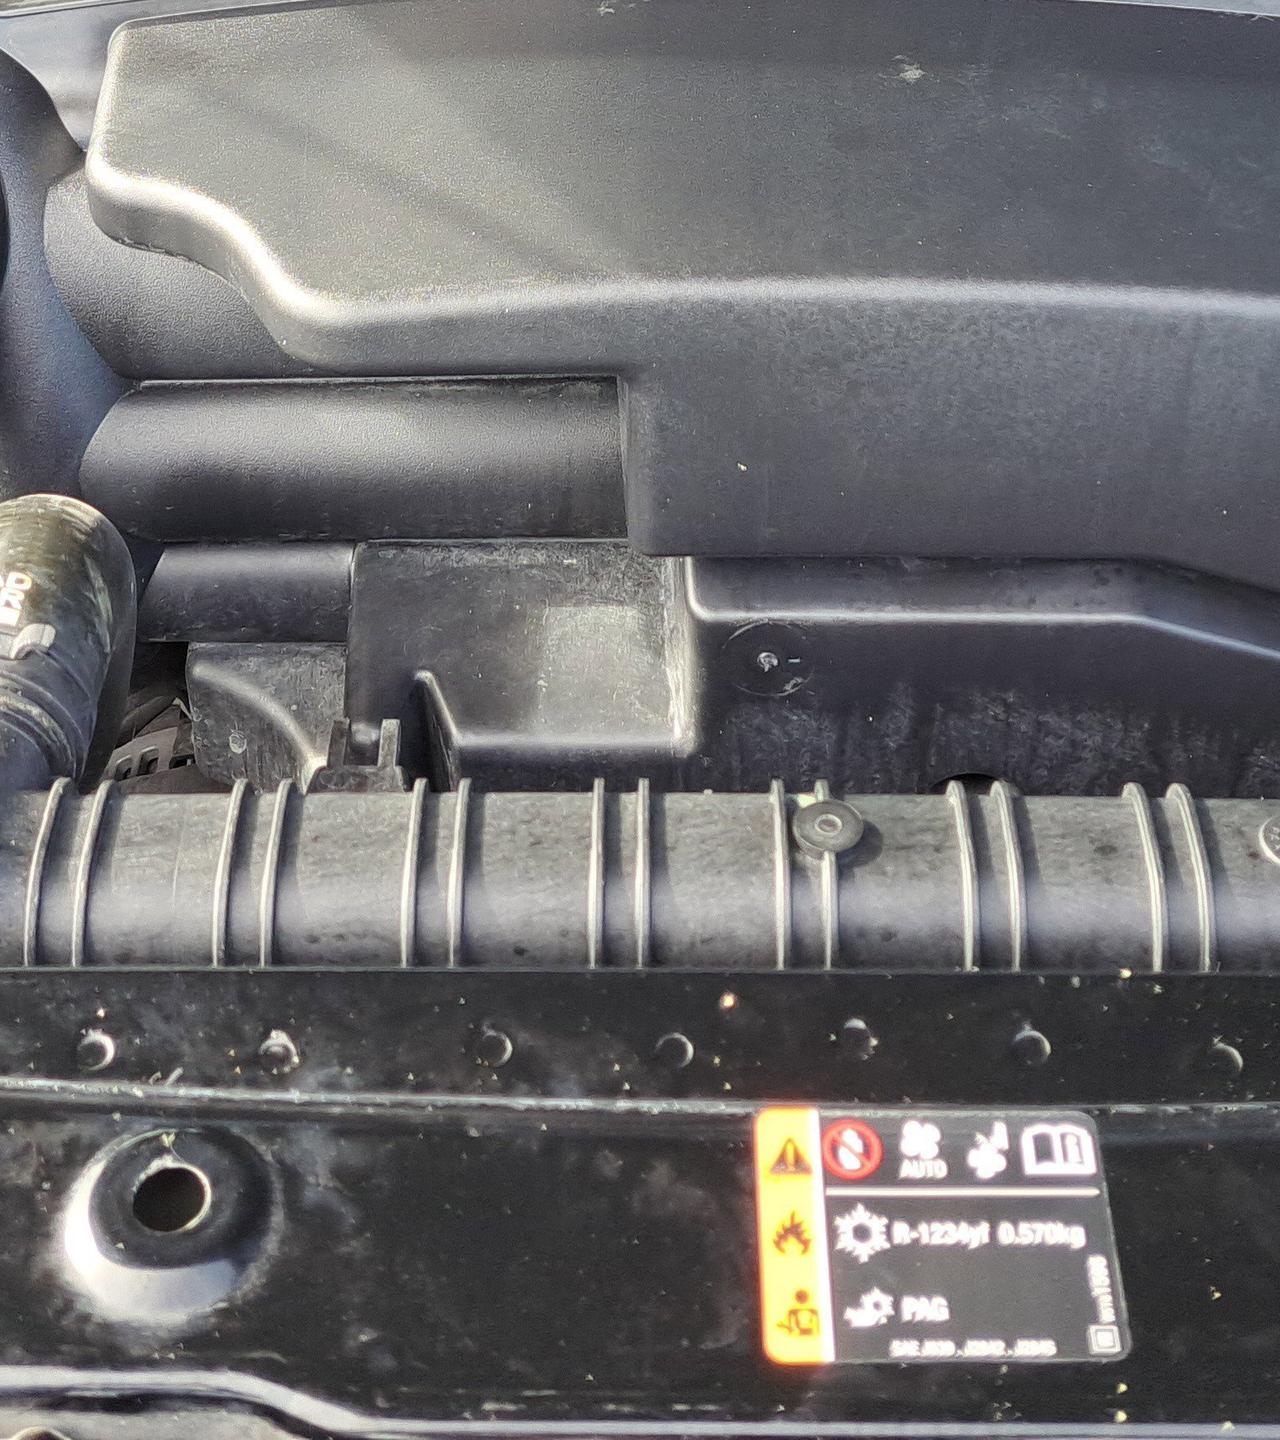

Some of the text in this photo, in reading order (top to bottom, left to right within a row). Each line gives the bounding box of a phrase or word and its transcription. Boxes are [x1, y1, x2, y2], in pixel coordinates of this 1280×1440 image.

[900, 1159, 948, 1179] AUTO
[892, 1221, 1087, 1249] R-1234yf 0.570kg
[901, 1296, 949, 1323] PAG
